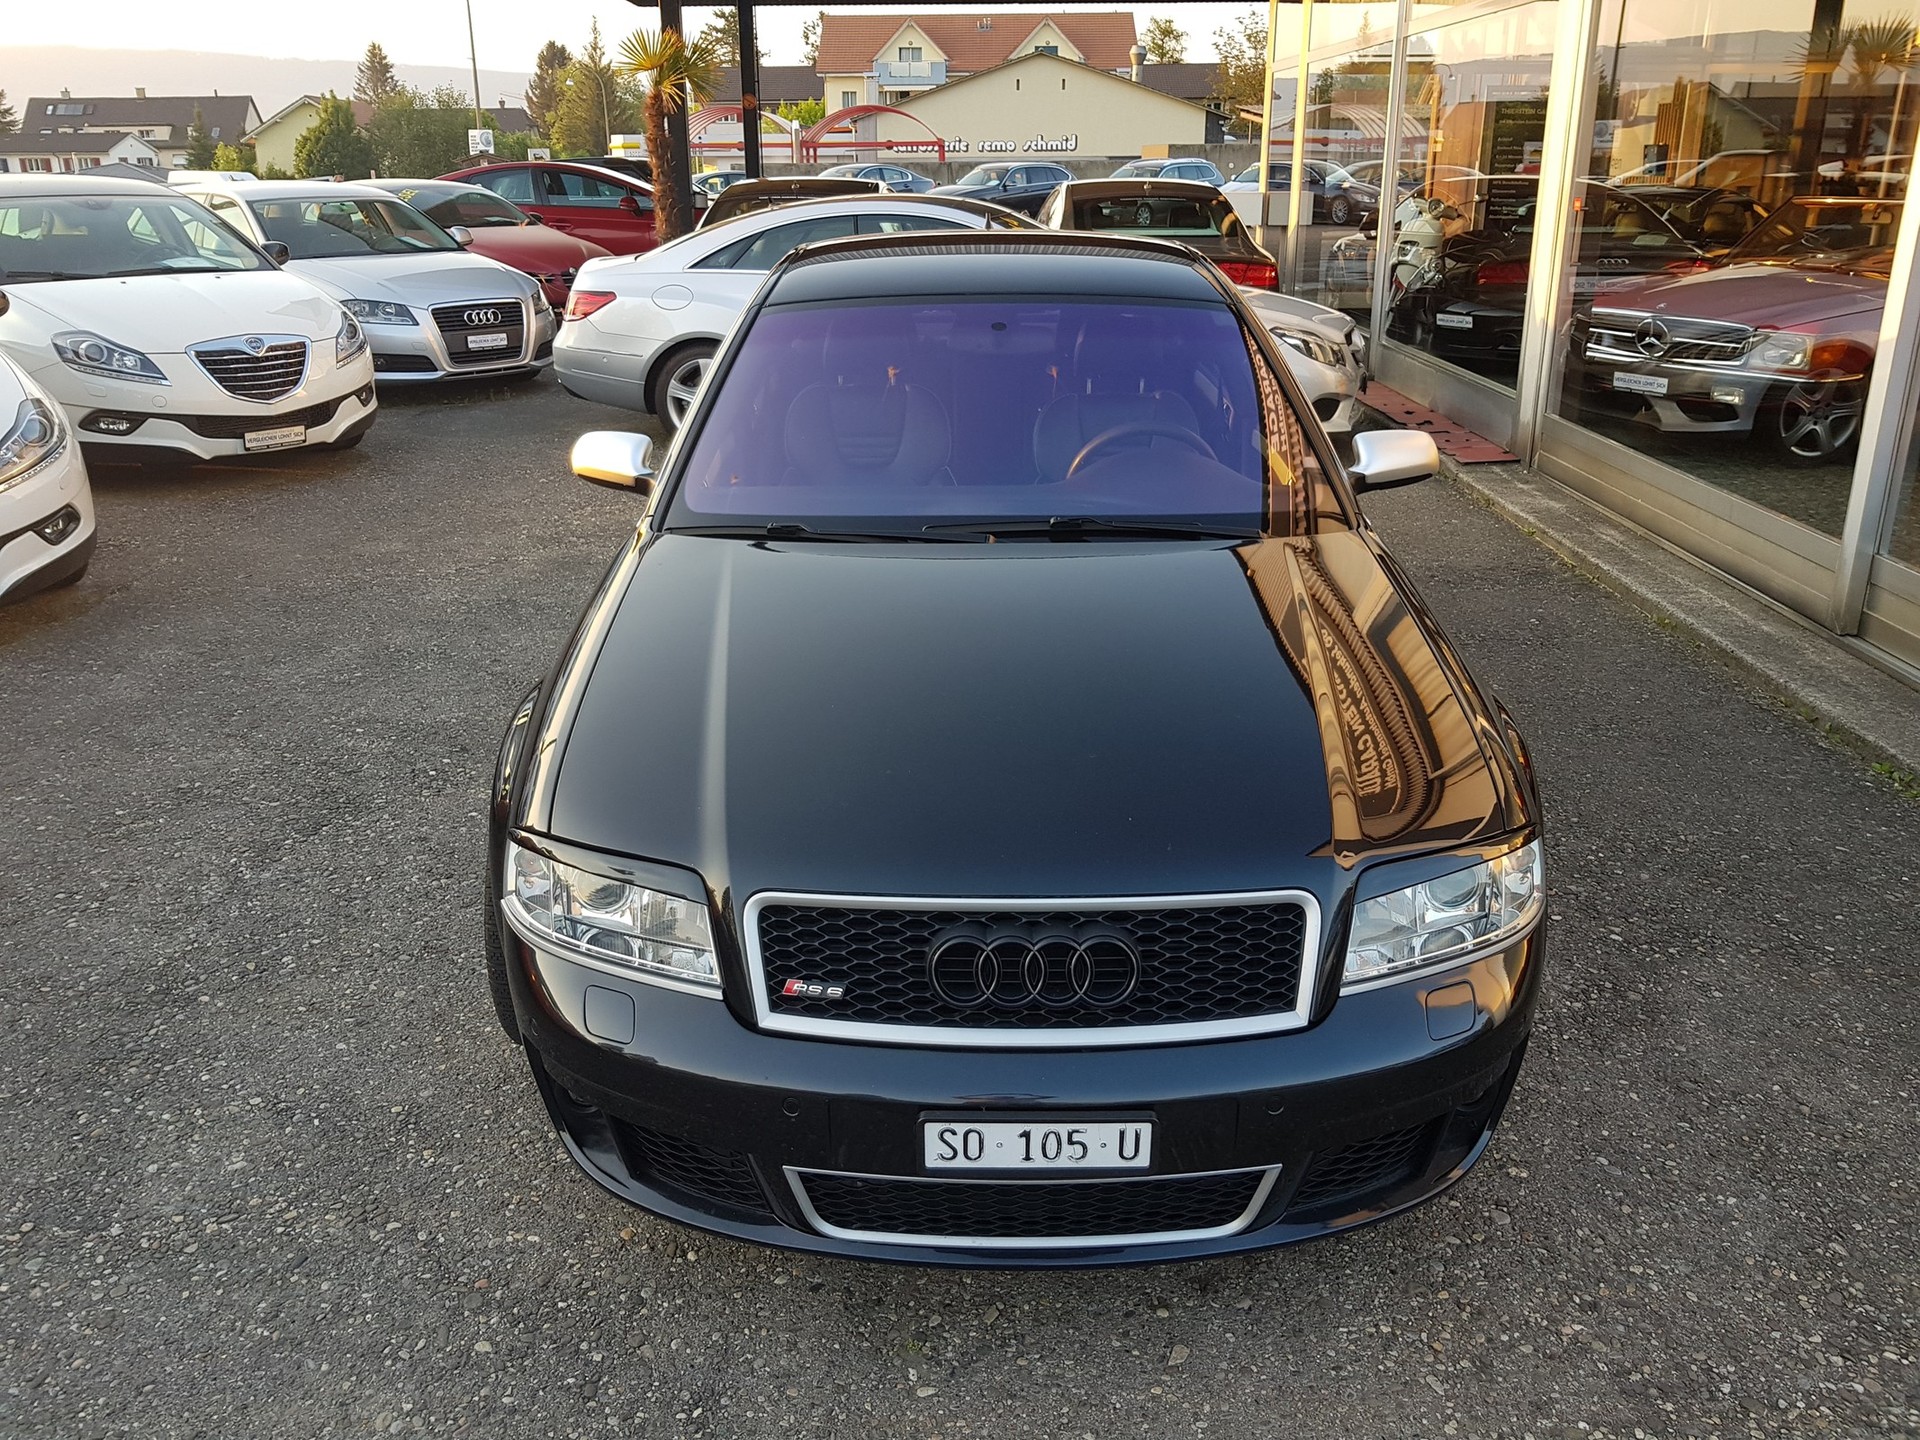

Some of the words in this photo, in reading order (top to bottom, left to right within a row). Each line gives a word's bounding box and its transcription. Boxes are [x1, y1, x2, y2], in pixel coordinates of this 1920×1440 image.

[978, 141, 1016, 153] remo
[1022, 134, 1078, 153] schmid
[1118, 1126, 1142, 1162] U
